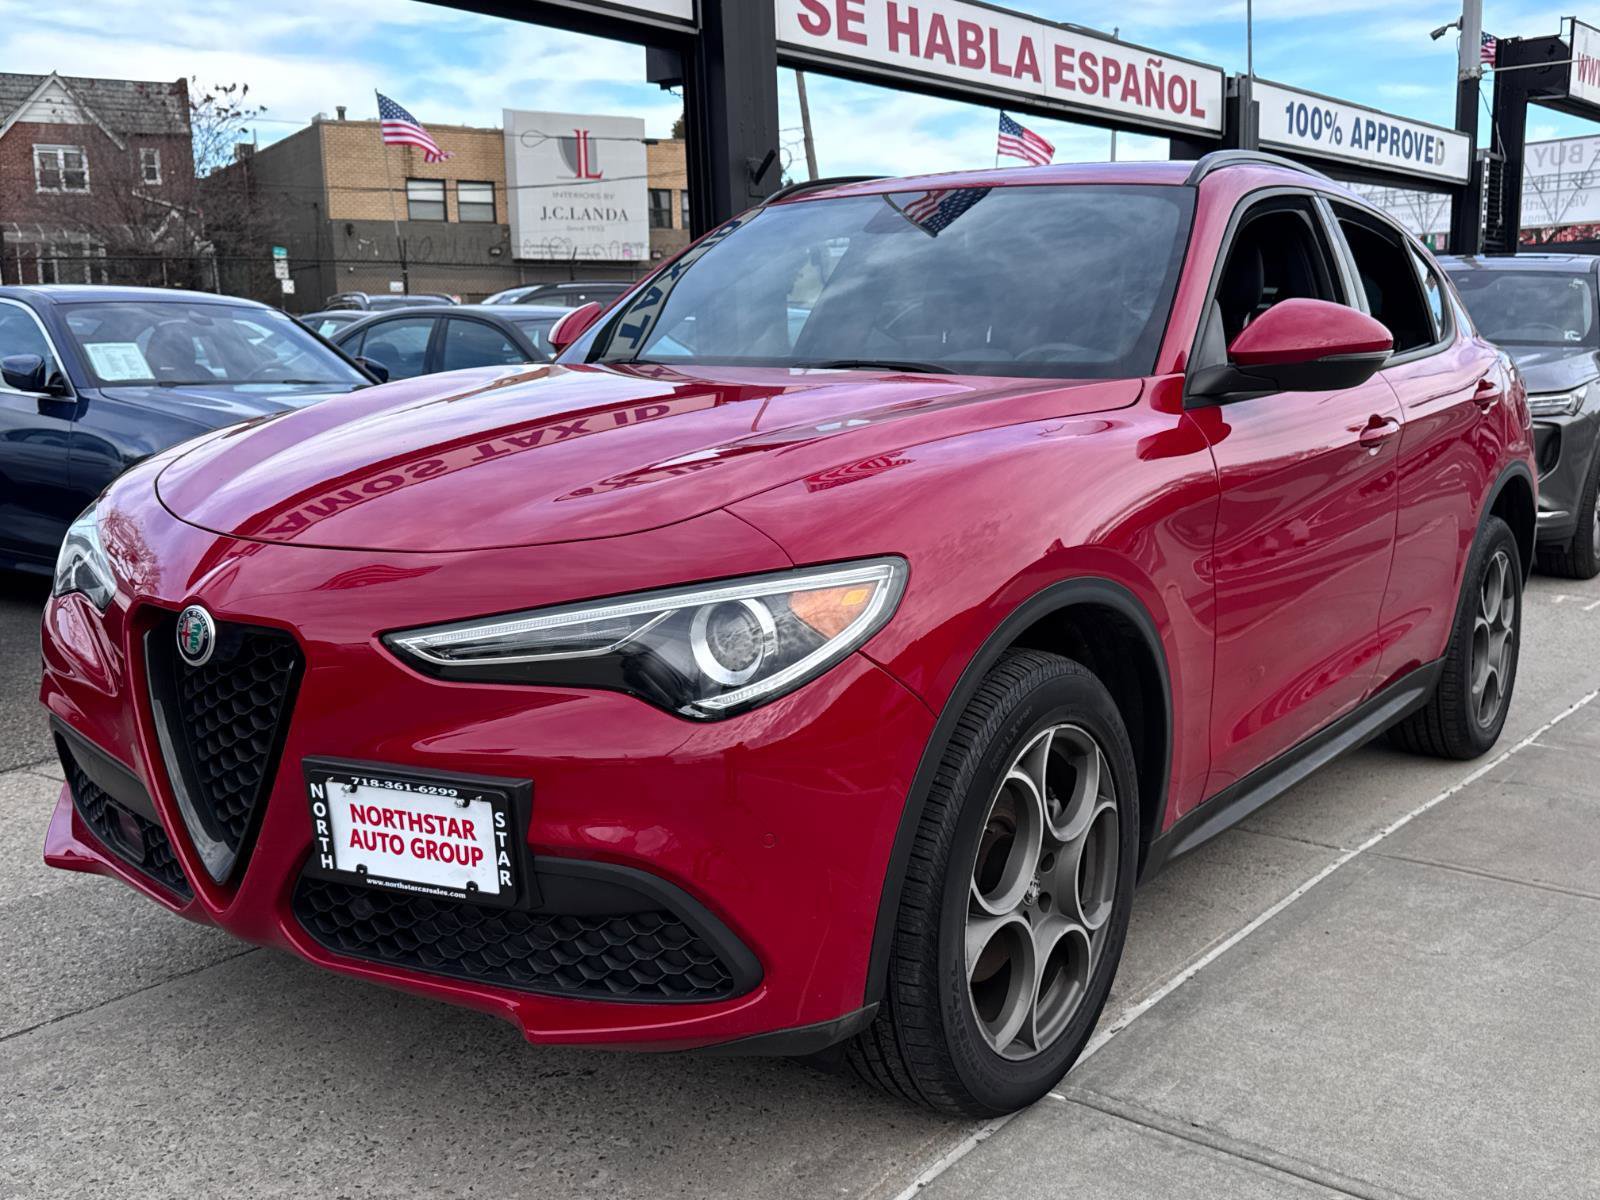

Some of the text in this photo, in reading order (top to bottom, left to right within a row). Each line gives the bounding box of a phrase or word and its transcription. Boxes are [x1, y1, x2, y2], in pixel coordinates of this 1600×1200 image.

[797, 0, 1205, 119] SE HABLA ESPAÑOL
[1285, 101, 1446, 166] 100% APPROVED
[540, 205, 629, 222] J.C.LANDA
[350, 776, 459, 798] 718-361-6299
[309, 782, 336, 870] NORTH
[350, 803, 478, 842] NORTHSTAR
[349, 828, 484, 868] AUTO GROUP
[494, 811, 513, 887] STAR
[366, 876, 467, 899] www.northstarcarsales.com
